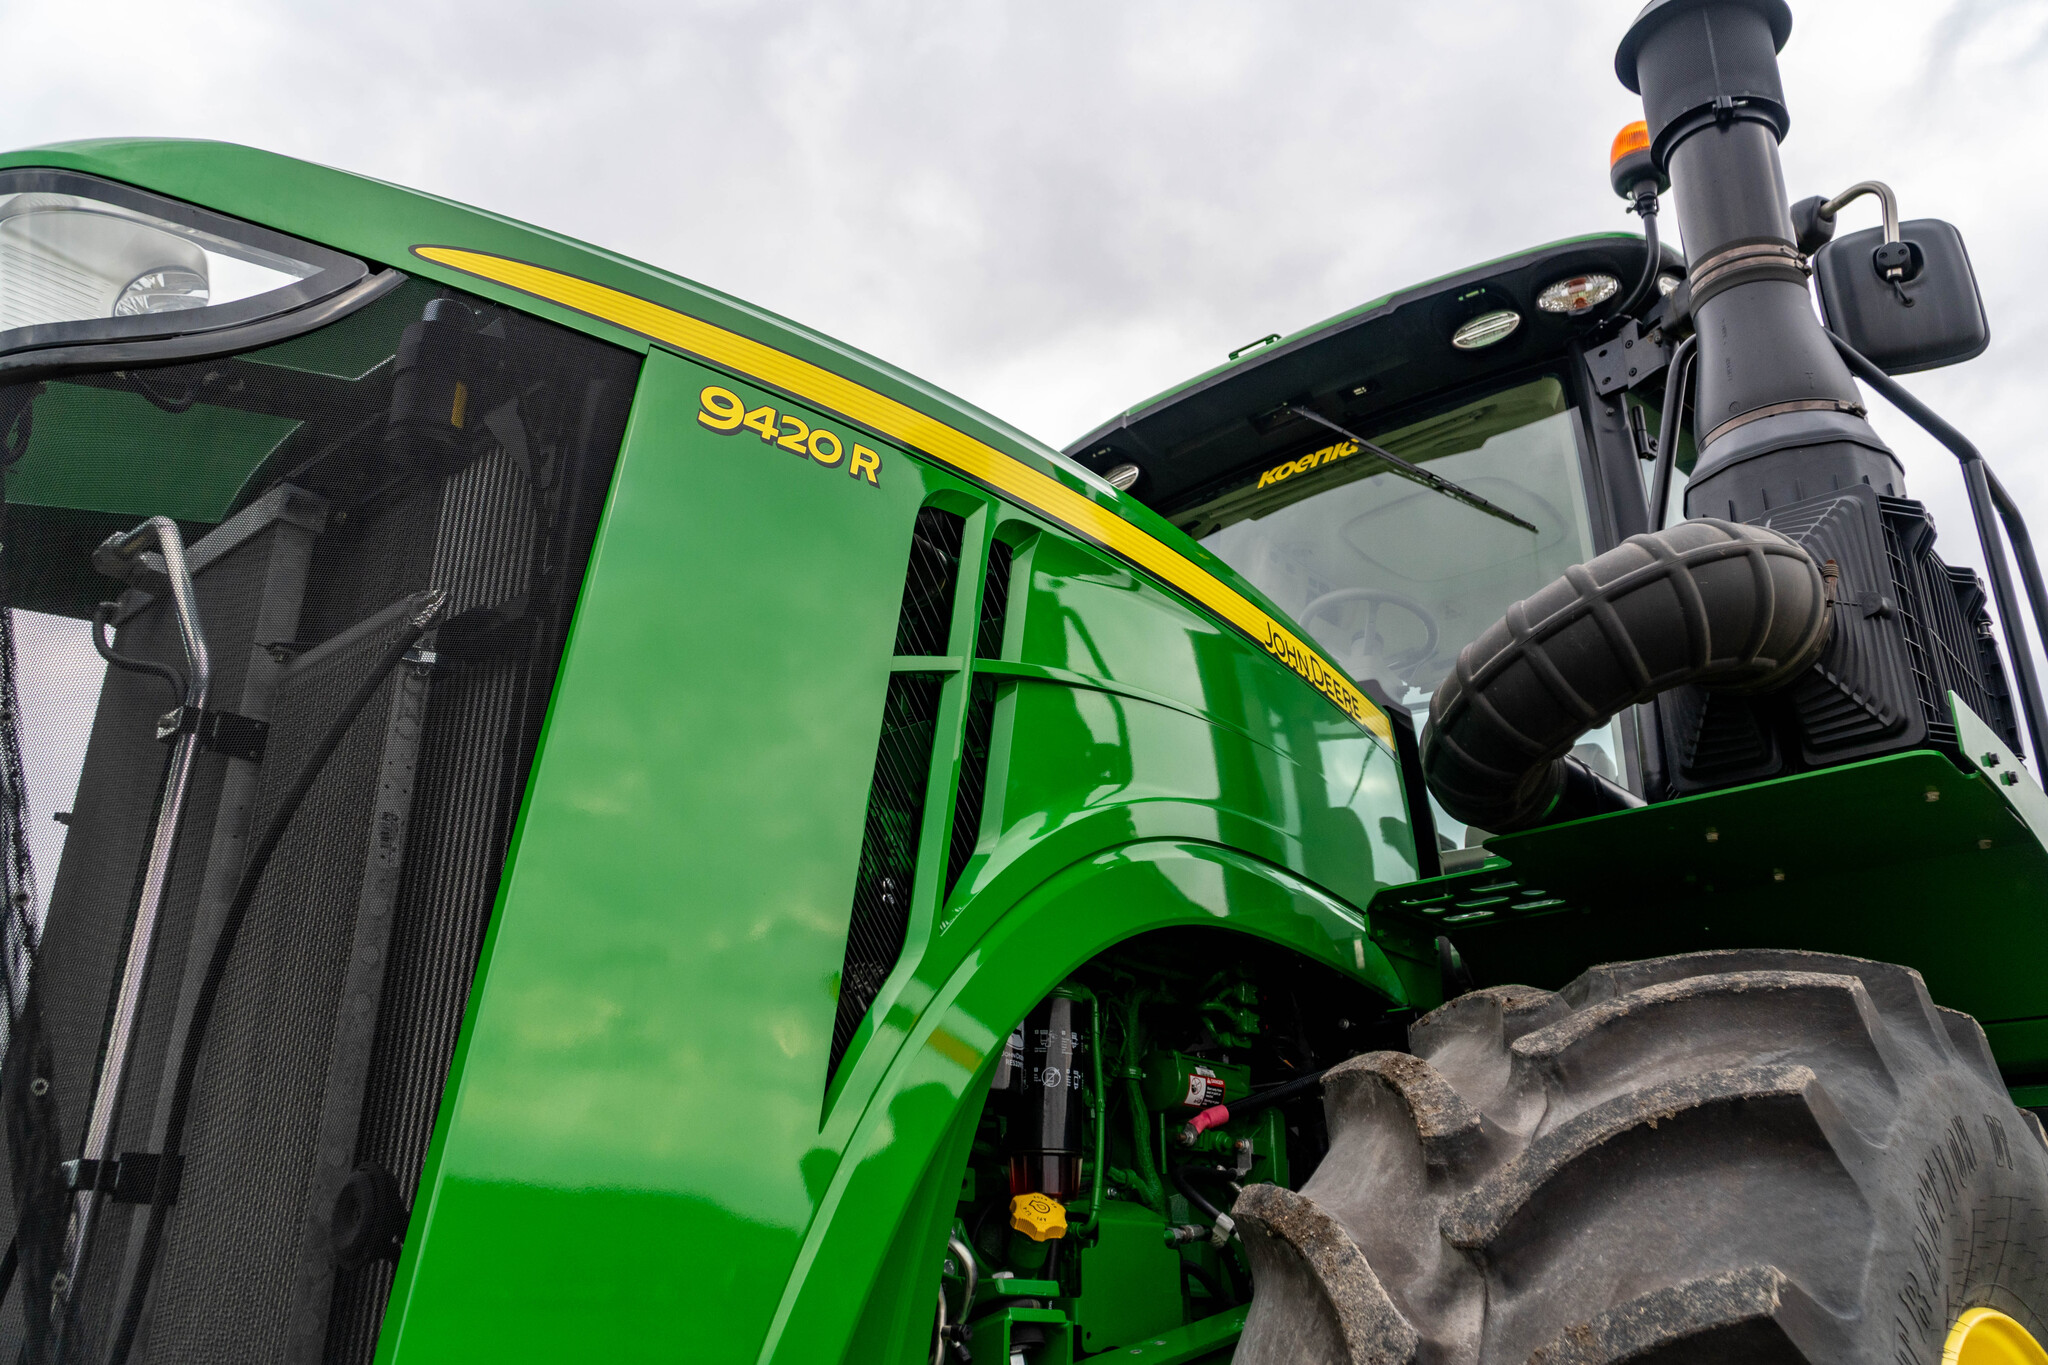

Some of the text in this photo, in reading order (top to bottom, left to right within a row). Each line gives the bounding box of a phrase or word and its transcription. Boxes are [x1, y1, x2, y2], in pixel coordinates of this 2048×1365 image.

[697, 385, 883, 489] 9420 R
[1265, 621, 1362, 720] JOHN DEERE
